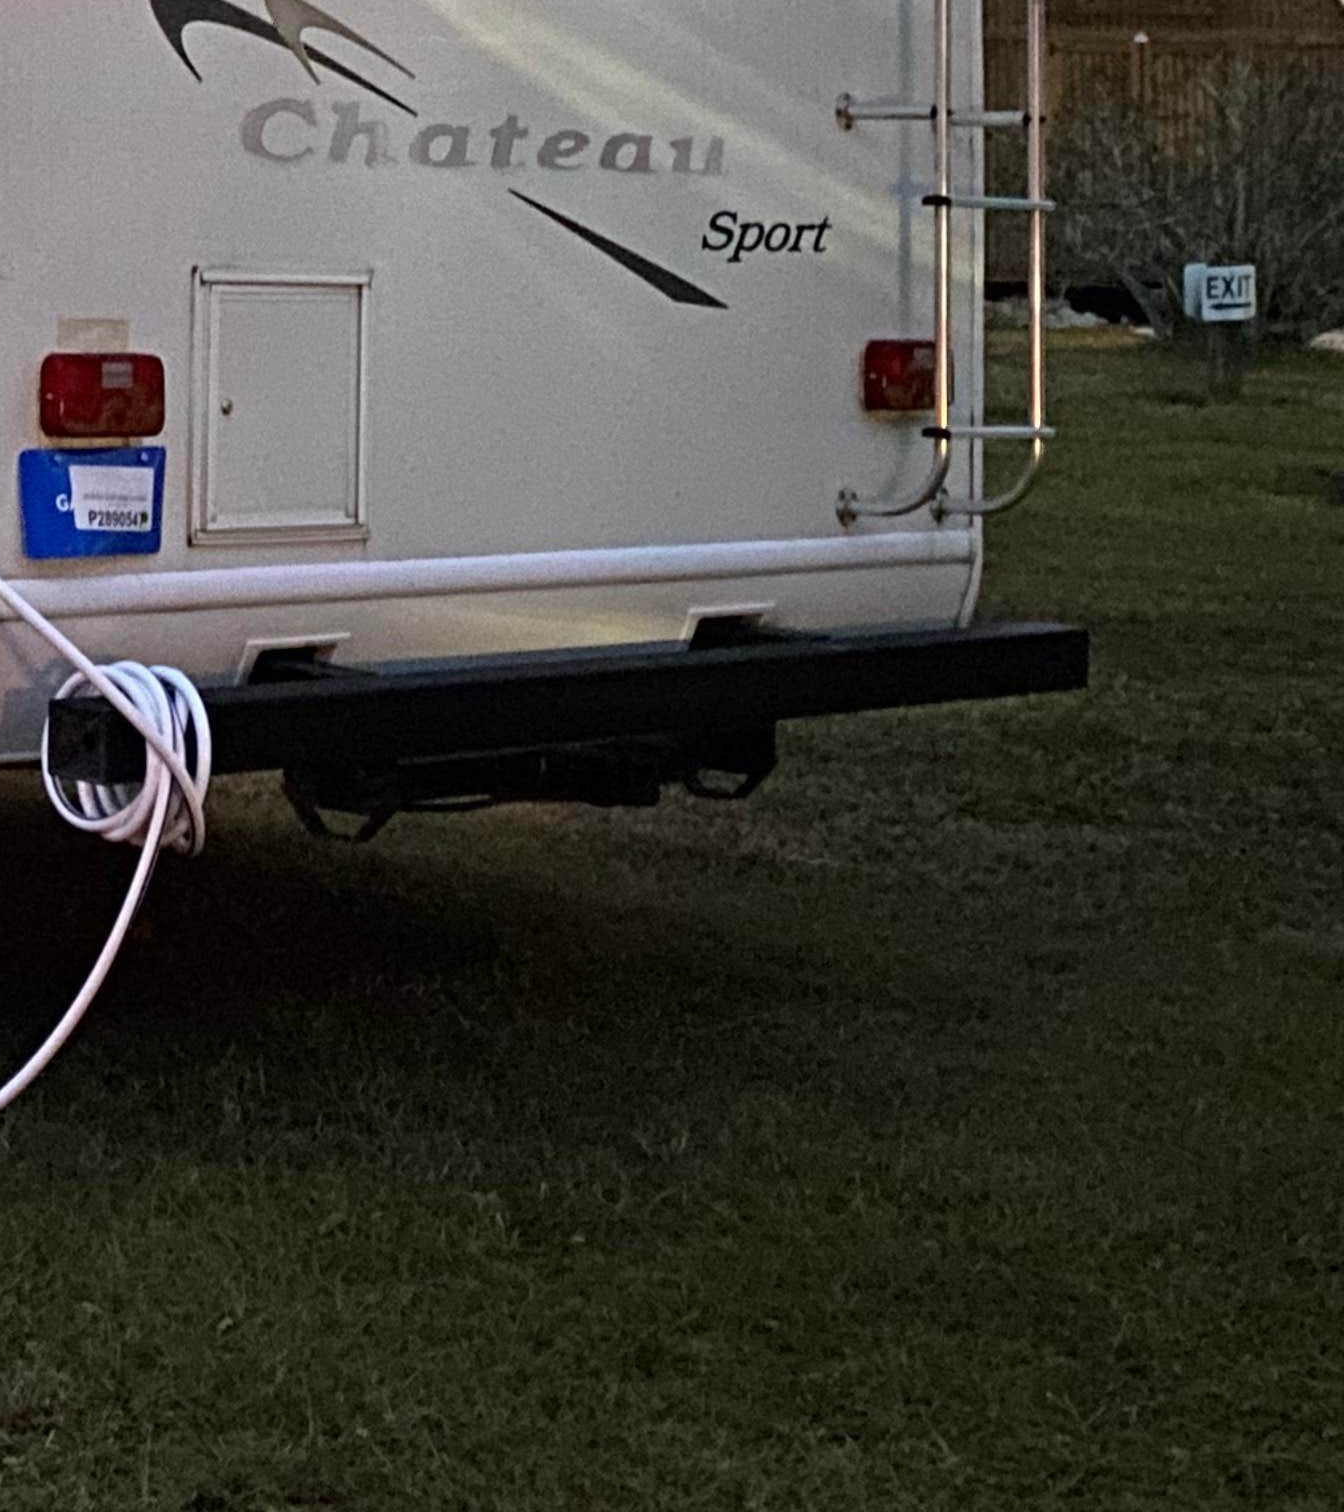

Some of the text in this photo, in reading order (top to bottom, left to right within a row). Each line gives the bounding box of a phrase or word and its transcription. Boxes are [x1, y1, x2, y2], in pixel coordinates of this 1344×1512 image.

[239, 96, 727, 177] Chateau
[701, 210, 833, 263] Sport
[1206, 275, 1252, 300] EXIT
